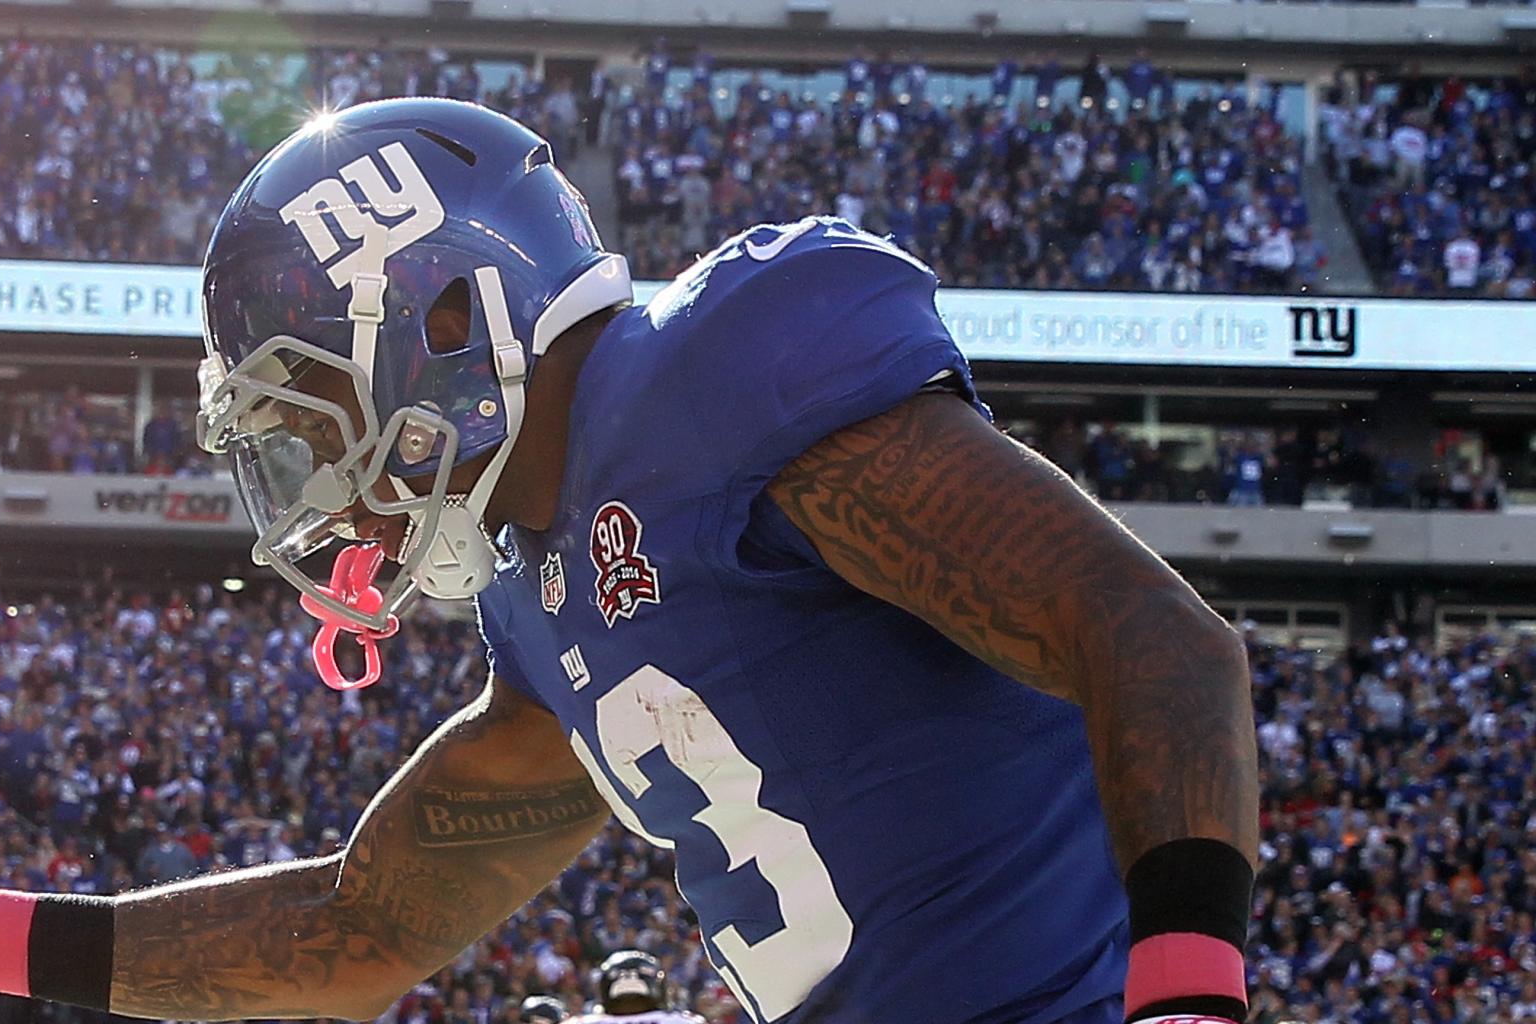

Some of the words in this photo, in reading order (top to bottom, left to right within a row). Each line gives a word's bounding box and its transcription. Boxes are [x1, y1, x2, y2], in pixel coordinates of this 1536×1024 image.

[949, 305, 1022, 344] roud
[1031, 313, 1165, 350] sponsor
[1171, 305, 1207, 348] of
[1214, 308, 1268, 350] the
[597, 514, 625, 563] 90
[544, 576, 563, 604] NFL
